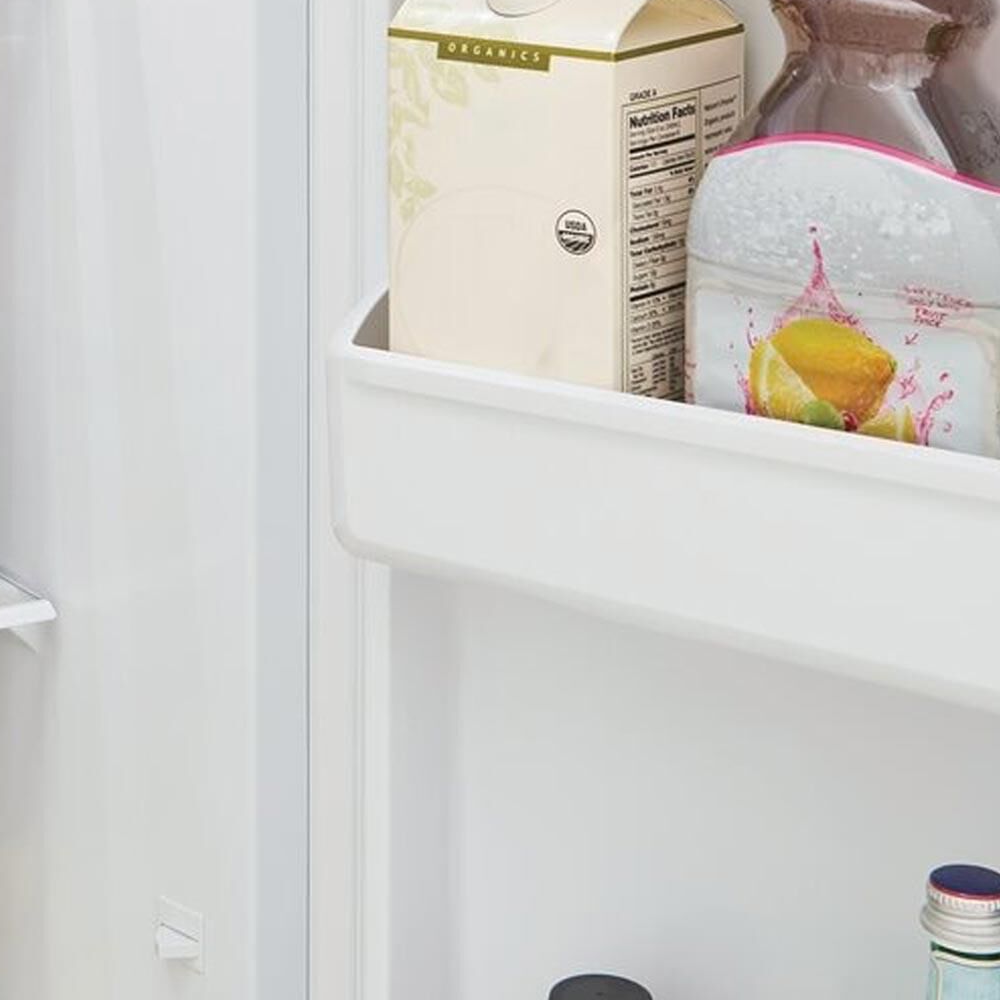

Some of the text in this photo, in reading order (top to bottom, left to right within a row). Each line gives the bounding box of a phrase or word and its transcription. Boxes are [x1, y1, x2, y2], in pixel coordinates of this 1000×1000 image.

[447, 41, 541, 63] ORGANICS
[629, 104, 696, 129] Nutrition Facts
[565, 220, 587, 231] USDA
